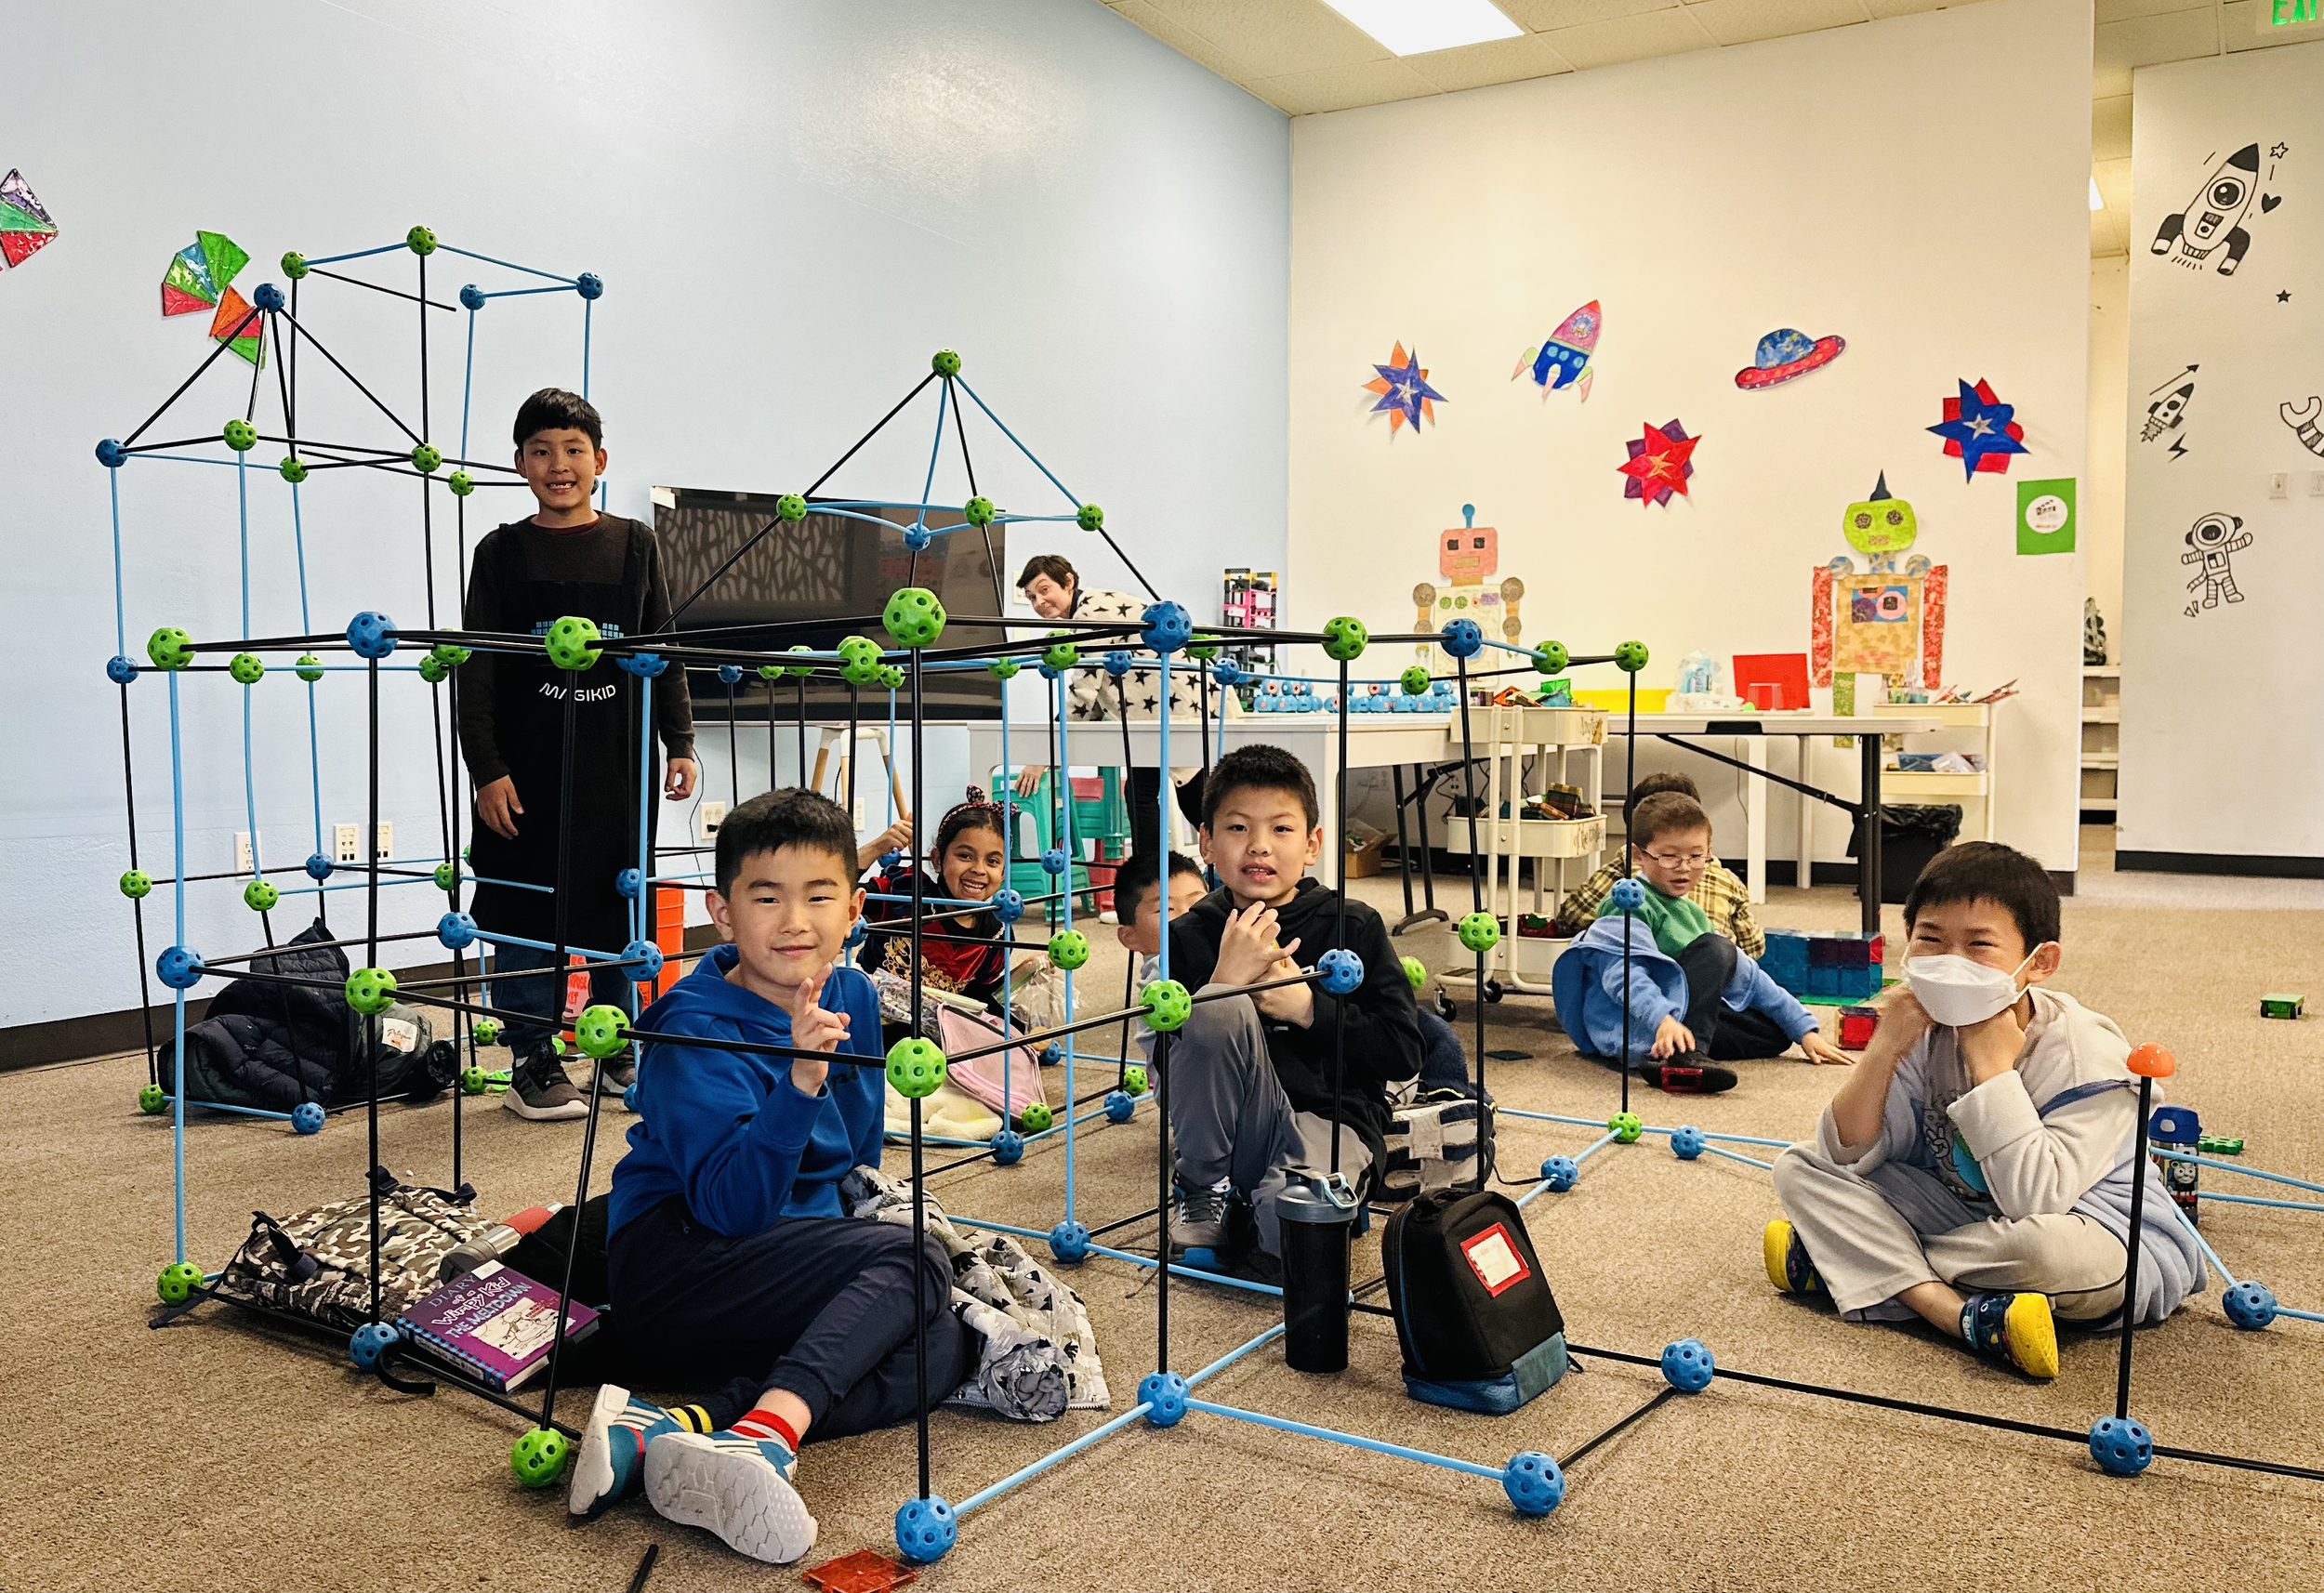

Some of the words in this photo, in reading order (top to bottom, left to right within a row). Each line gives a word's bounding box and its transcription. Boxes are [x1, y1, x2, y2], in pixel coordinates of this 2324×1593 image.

[2272, 0, 2324, 26] EXI
[429, 1275, 476, 1308] DIARY
[431, 1294, 485, 1326] Wimpy
[479, 1276, 512, 1297] Kid
[453, 1295, 467, 1305] of
[467, 1289, 477, 1297] a
[445, 1319, 474, 1338] THE
[470, 1282, 532, 1326] MELTDOWN
